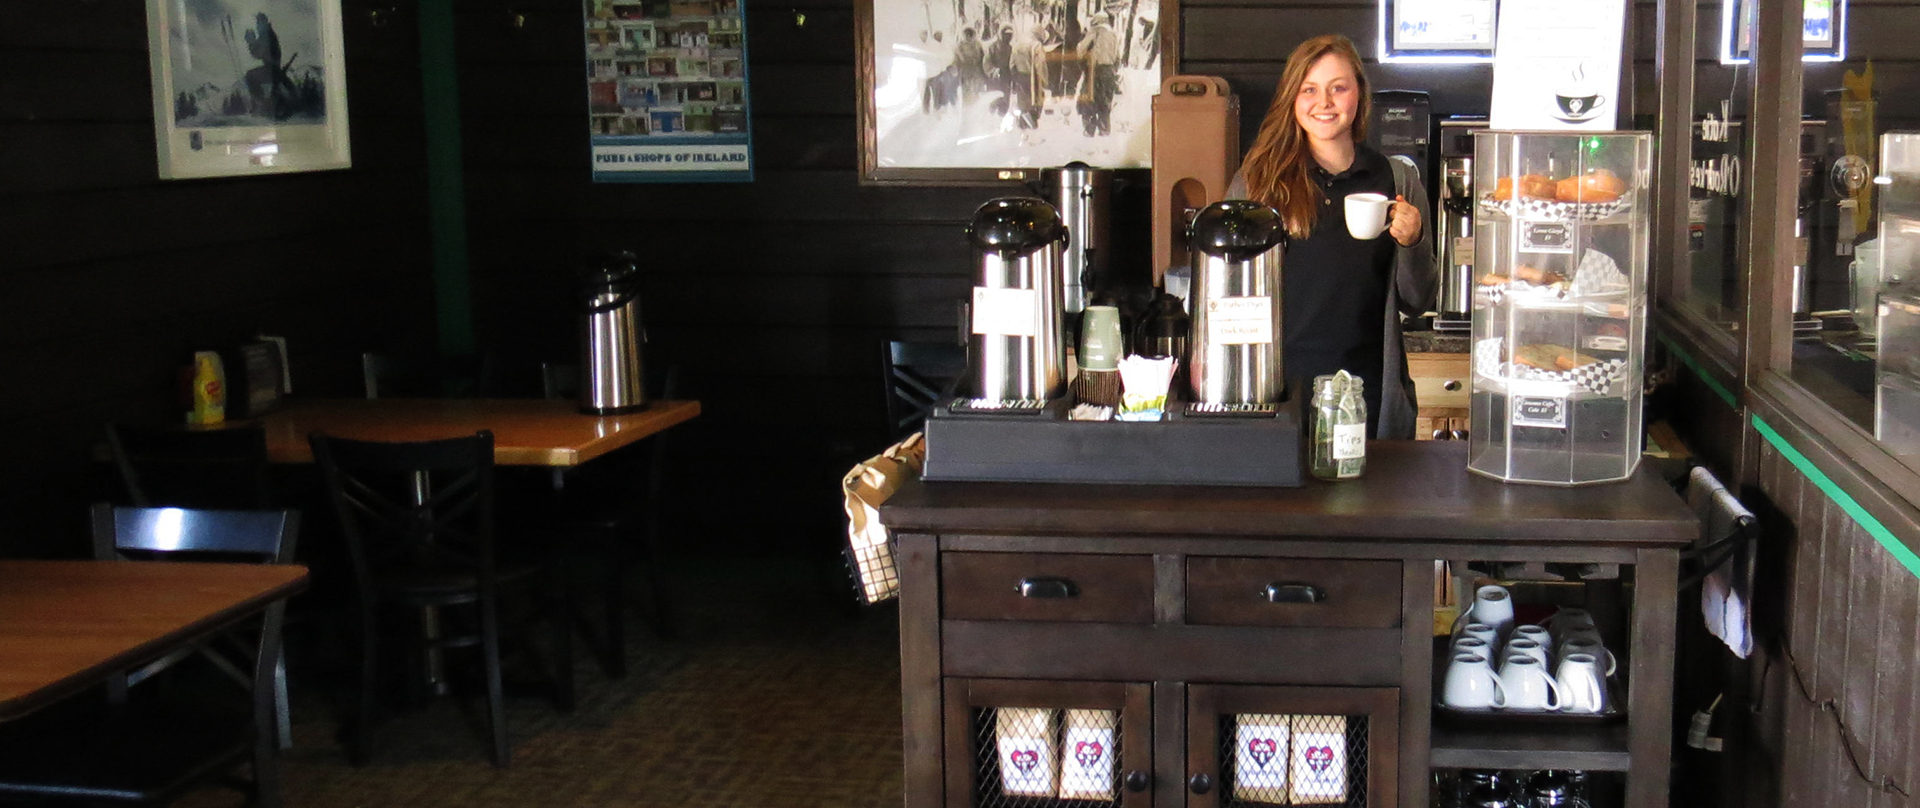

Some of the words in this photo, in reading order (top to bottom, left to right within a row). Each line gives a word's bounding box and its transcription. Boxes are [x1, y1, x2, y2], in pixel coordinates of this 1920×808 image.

[597, 153, 625, 163] PUBS
[634, 153, 672, 163] SHOPS
[675, 153, 690, 162] OF
[693, 153, 746, 162] IRELAND
[1337, 433, 1362, 445] Tips
